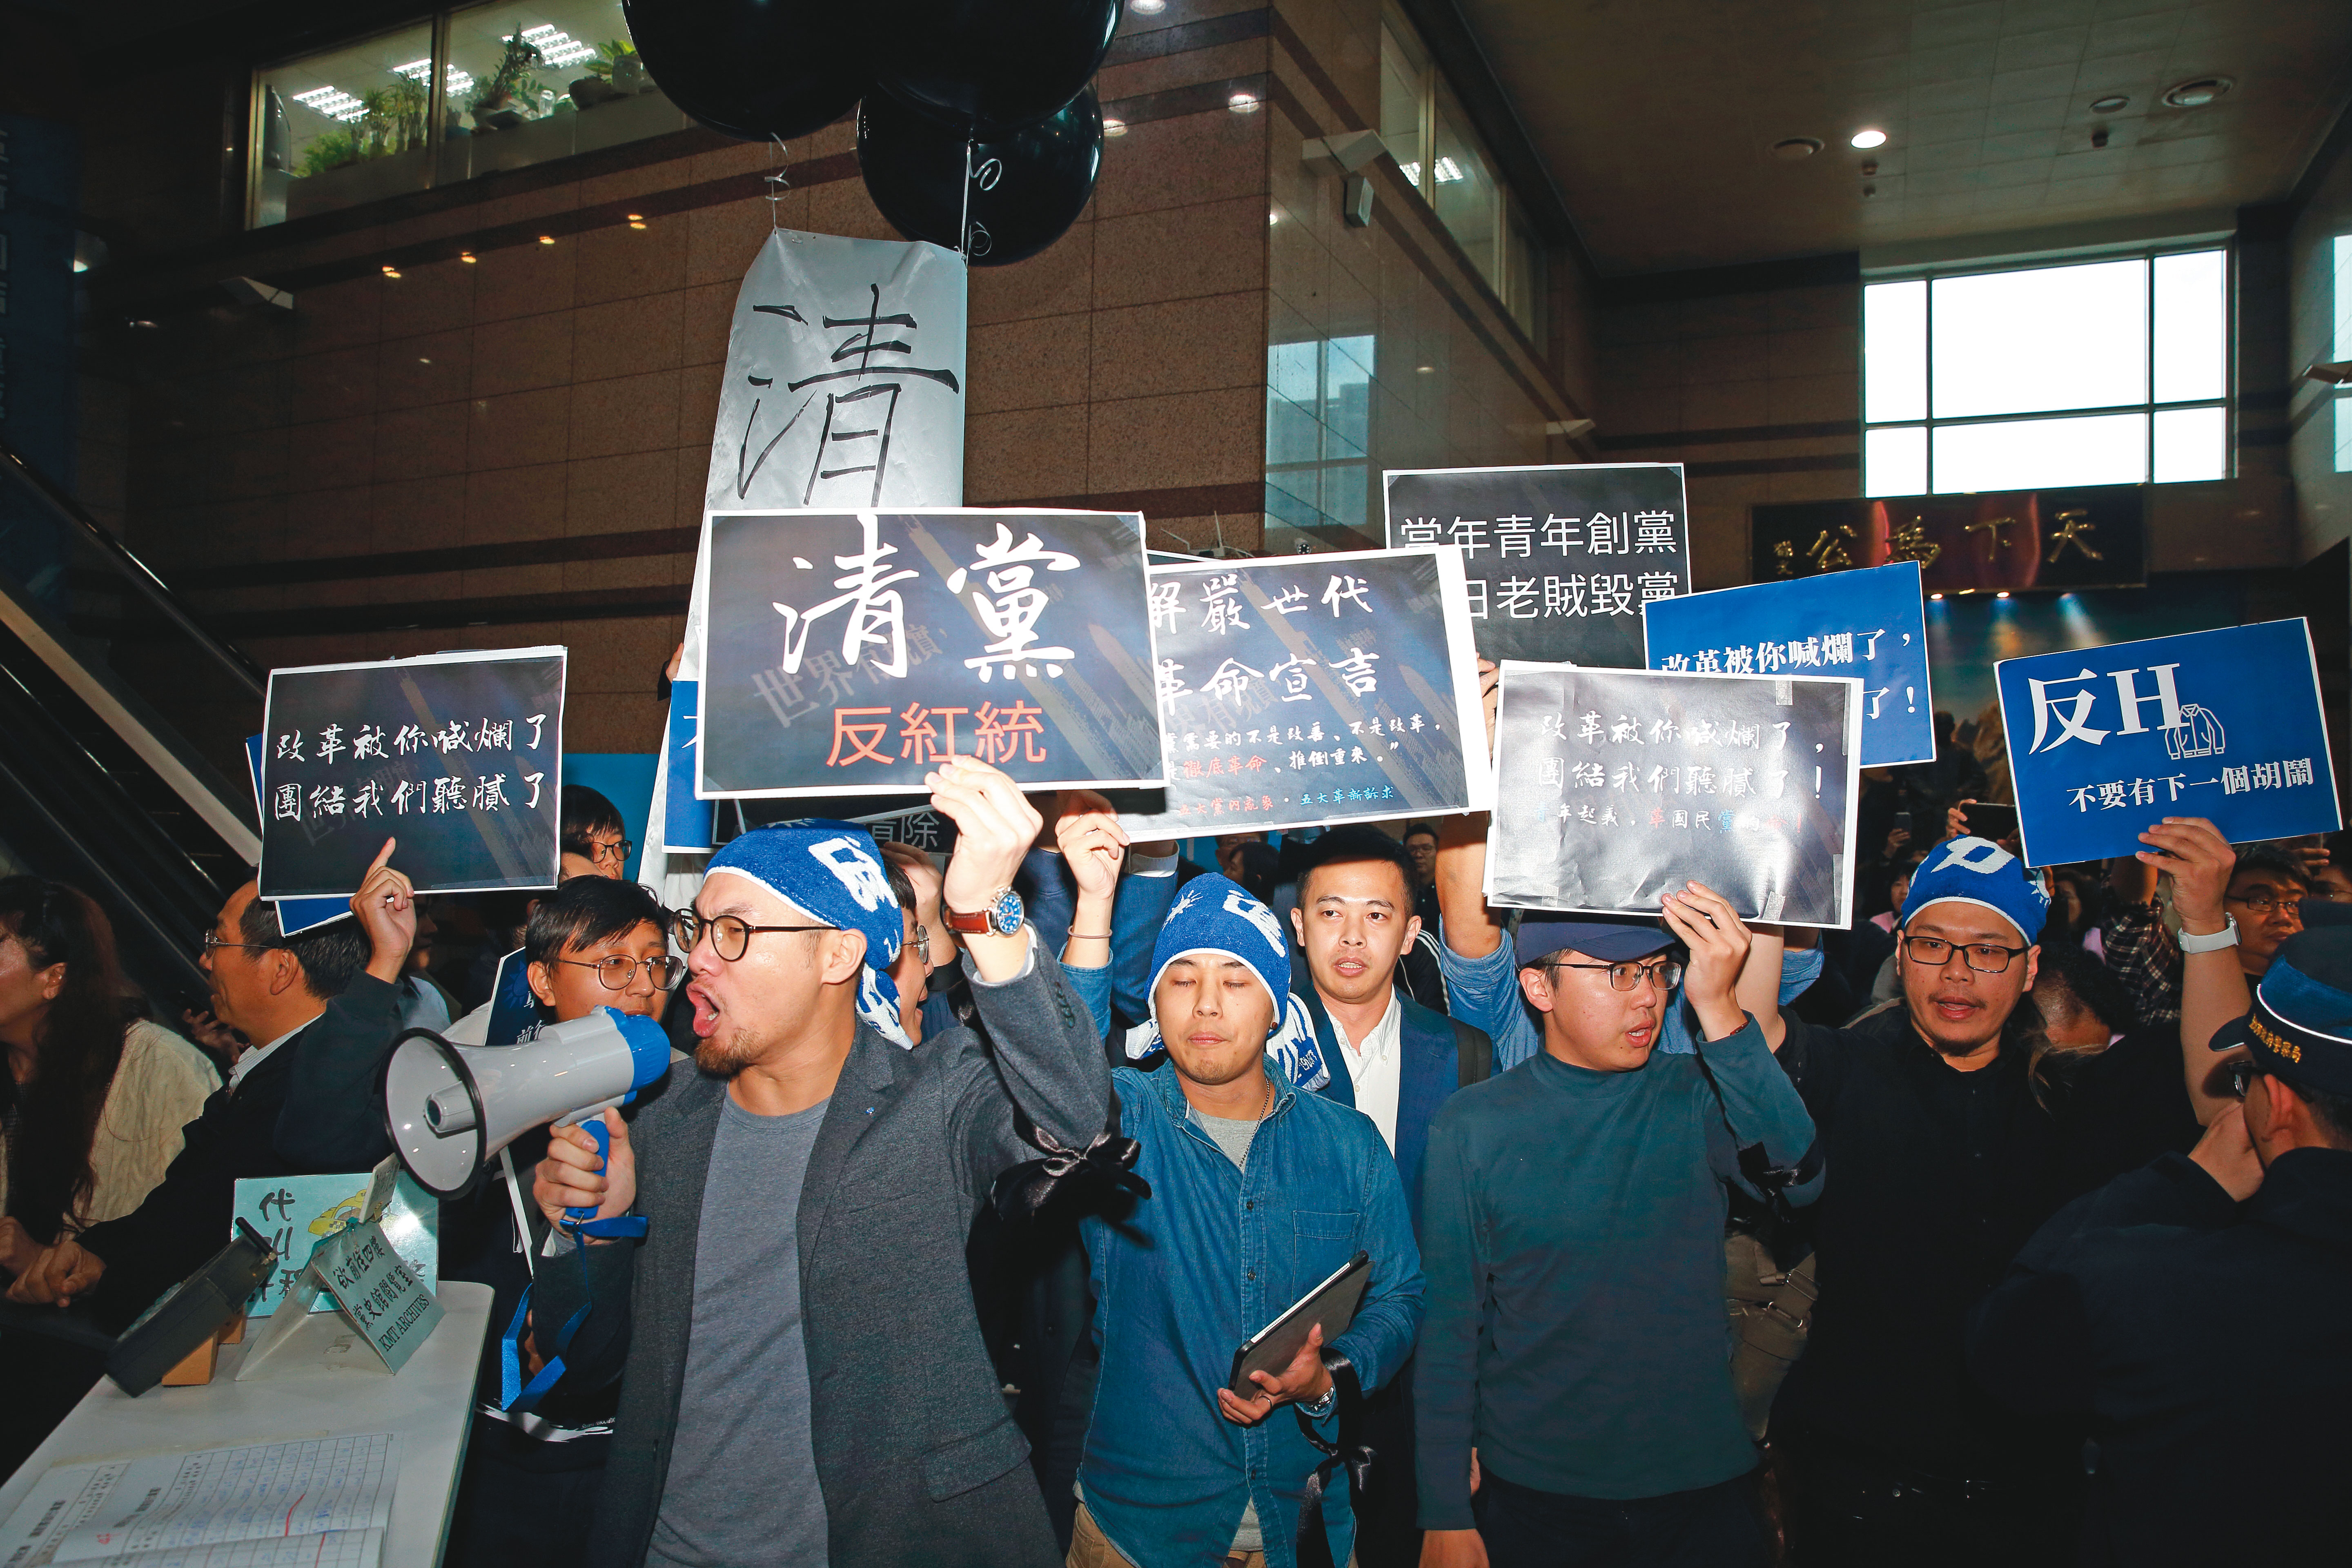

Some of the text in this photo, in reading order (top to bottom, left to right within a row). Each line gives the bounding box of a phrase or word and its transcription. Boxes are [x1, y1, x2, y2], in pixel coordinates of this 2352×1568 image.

[737, 283, 959, 507] 清
[1401, 510, 1677, 559] 當年青年創黨
[772, 513, 1080, 683] 清黨
[1151, 573, 1374, 635] 解嚴世代
[1158, 647, 1381, 716] 革命宣言
[2028, 663, 2190, 755] 反H
[276, 713, 548, 764] 改革被你喊爛了
[826, 700, 1047, 767] 反紅統
[1540, 710, 1824, 754] 改革被你喊爛了，
[274, 772, 545, 821] 團結我們聽膩了
[1538, 756, 1823, 800] 團結我們聽膩了！
[2066, 757, 2313, 813] 不要有下一個胡鬧
[379, 1325, 401, 1352] KMT
[395, 1294, 430, 1335] ARCHIVES
